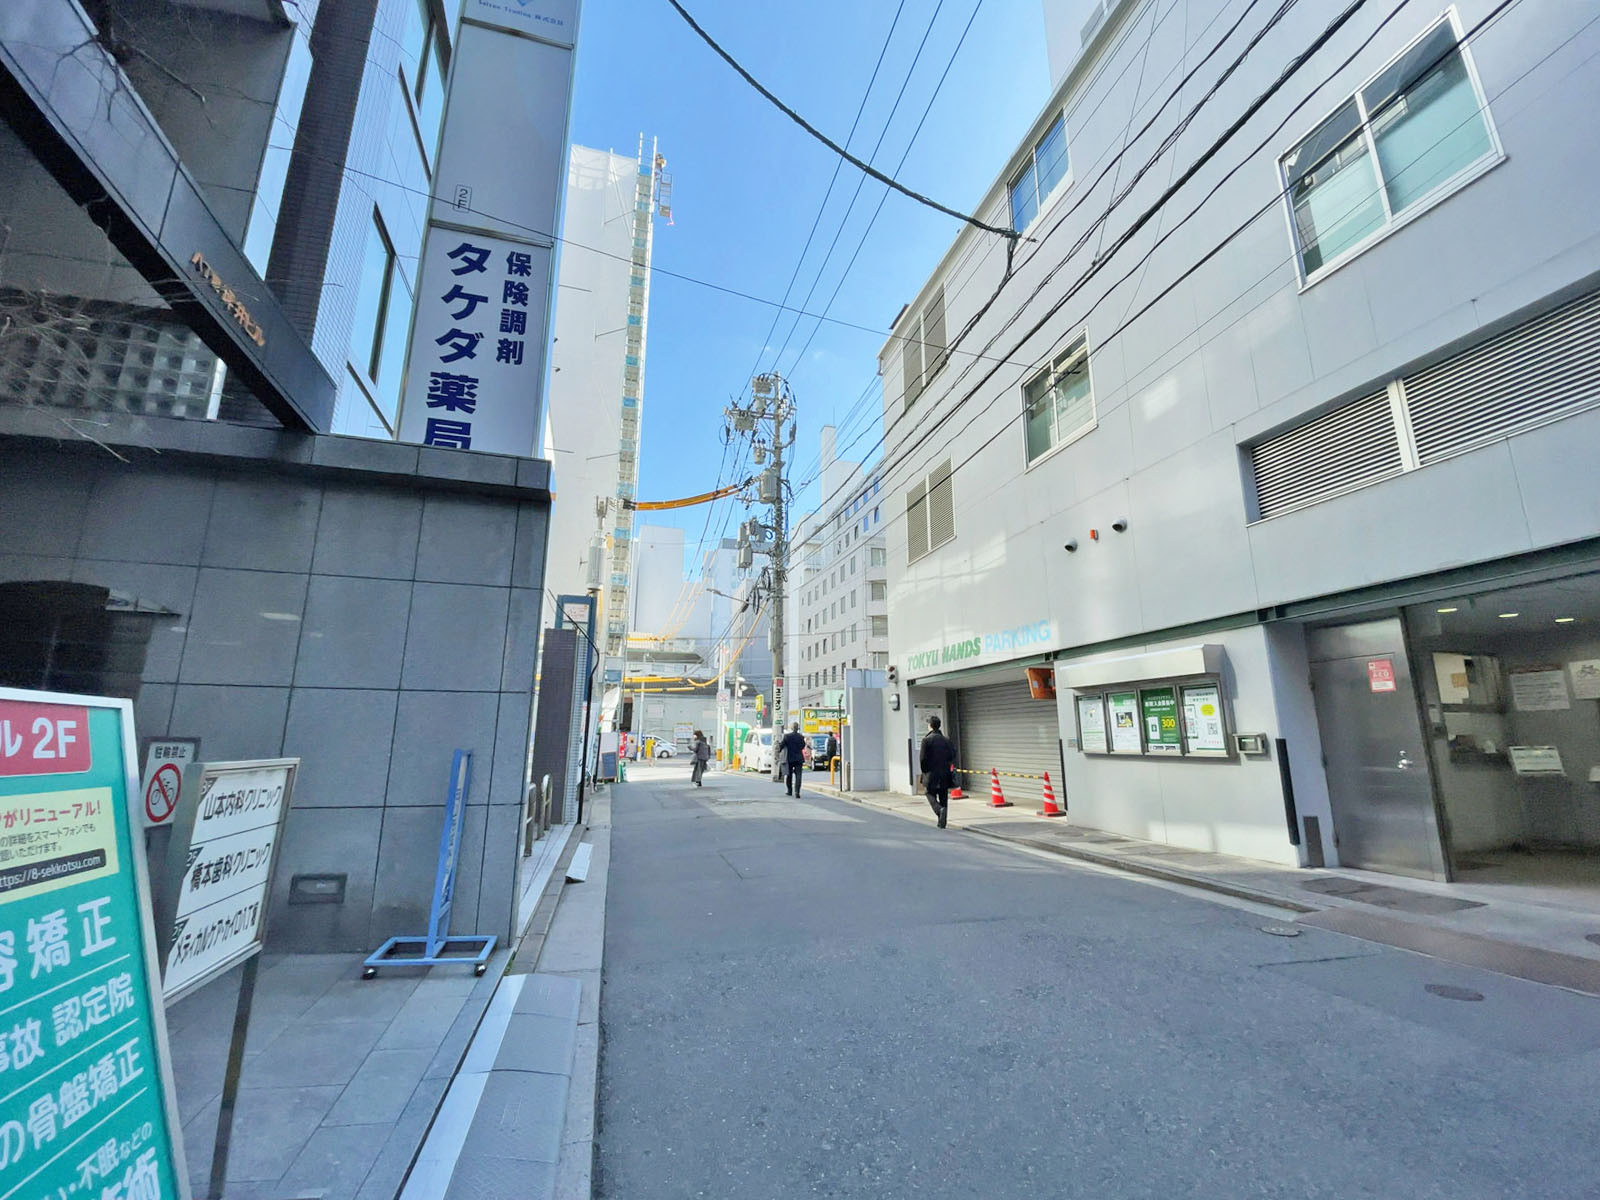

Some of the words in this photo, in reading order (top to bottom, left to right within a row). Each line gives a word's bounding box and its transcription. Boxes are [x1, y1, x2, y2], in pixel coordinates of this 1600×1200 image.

[496, 251, 532, 365] 保険調剤
[424, 243, 491, 450] タケダ薬局
[907, 649, 939, 671] TOKYU
[942, 637, 981, 664] HANDS
[984, 619, 1051, 653] PARKING
[32, 717, 77, 759] 2F
[0, 800, 101, 829] がリニューアル!
[203, 786, 282, 821] 山本内科クリニック
[190, 842, 271, 893] 橋本歯科クリニック
[0, 1017, 45, 1073] 故
[52, 972, 135, 1047] 認定院
[0, 1037, 144, 1172] の骨盤矯正
